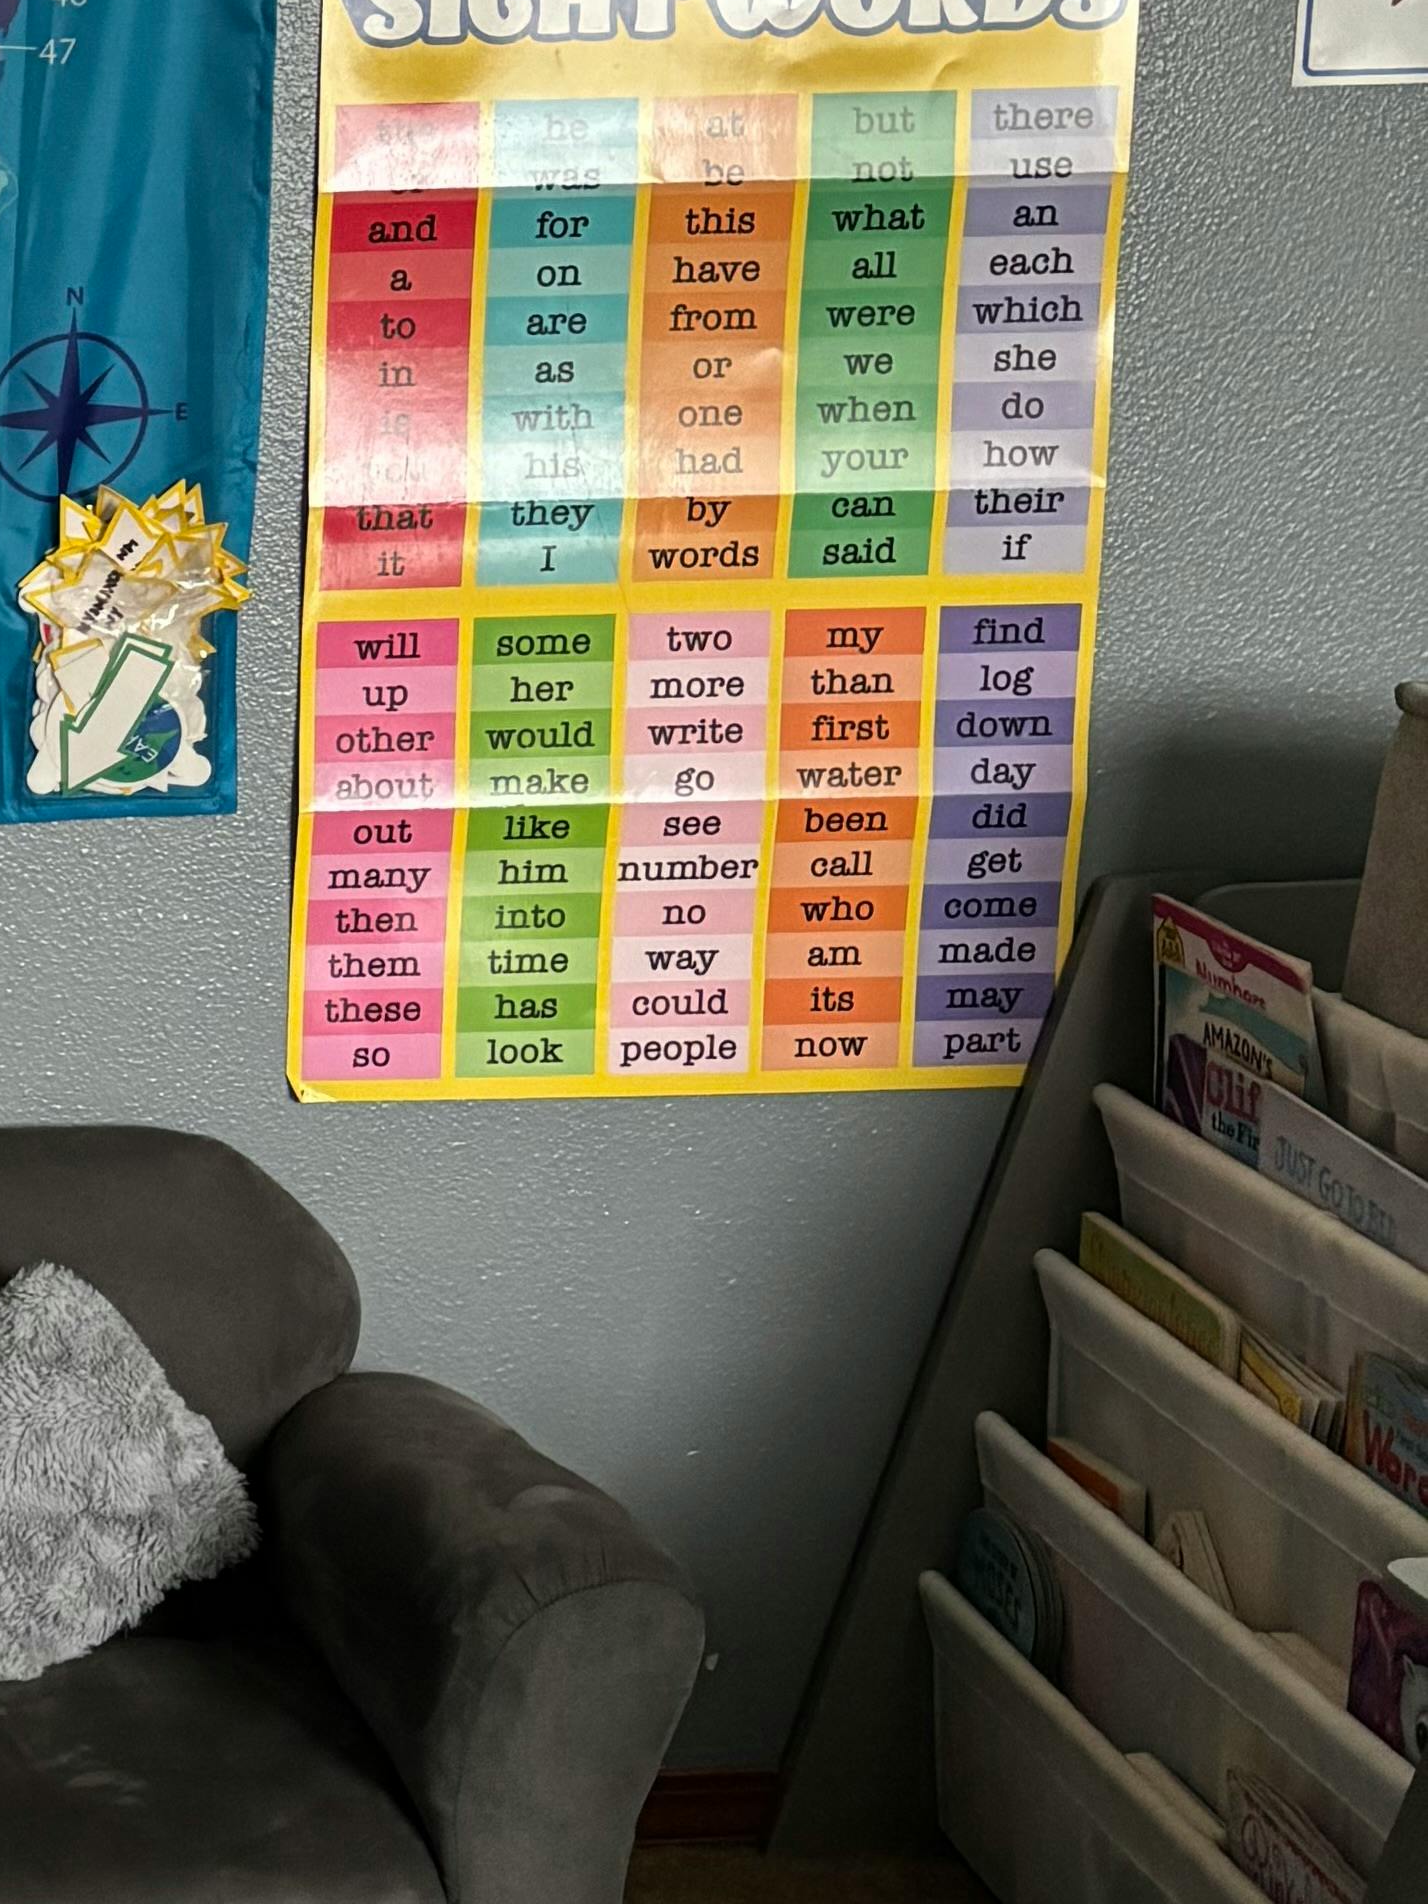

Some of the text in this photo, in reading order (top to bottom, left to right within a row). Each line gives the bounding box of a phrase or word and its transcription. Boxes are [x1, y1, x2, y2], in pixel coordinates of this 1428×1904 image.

[853, 106, 915, 134] but
[994, 103, 1093, 131] there
[1011, 157, 1072, 179] use
[369, 214, 437, 243] and
[536, 211, 589, 238] for
[686, 208, 754, 234] this
[832, 204, 924, 231] what
[1014, 205, 1058, 227] an
[673, 257, 760, 283] have
[852, 251, 896, 279] all
[990, 247, 1074, 275] each
[537, 265, 581, 287] on
[670, 304, 756, 331] from
[826, 305, 915, 327] were
[973, 295, 1082, 324] which
[527, 313, 586, 335] are
[994, 344, 1056, 371] she
[679, 405, 742, 427] one
[817, 396, 916, 423] when
[1002, 392, 1043, 419] do
[687, 497, 731, 527] by
[832, 497, 895, 517] can
[975, 488, 1064, 514] their
[351, 504, 433, 531] that
[512, 501, 594, 531] they
[649, 541, 758, 568] words
[823, 537, 896, 565] said
[1003, 534, 1032, 560] if
[497, 634, 590, 656] some
[667, 627, 732, 651] two
[827, 627, 883, 654] my
[811, 669, 894, 695] than
[980, 665, 1034, 696] log
[486, 721, 594, 749] would
[648, 719, 743, 745] write
[812, 715, 889, 741] first
[797, 762, 901, 788] water
[504, 815, 569, 840] like
[618, 855, 758, 881] number
[811, 851, 872, 877] call
[328, 868, 431, 893] many
[495, 905, 565, 929] into
[488, 950, 568, 974] time
[938, 937, 1035, 963] made
[633, 989, 728, 1015] could
[487, 1038, 563, 1064] look
[620, 1034, 736, 1067] people
[1203, 1021, 1273, 1079] AMAZON'S
[1274, 1136, 1316, 1189] JUST
